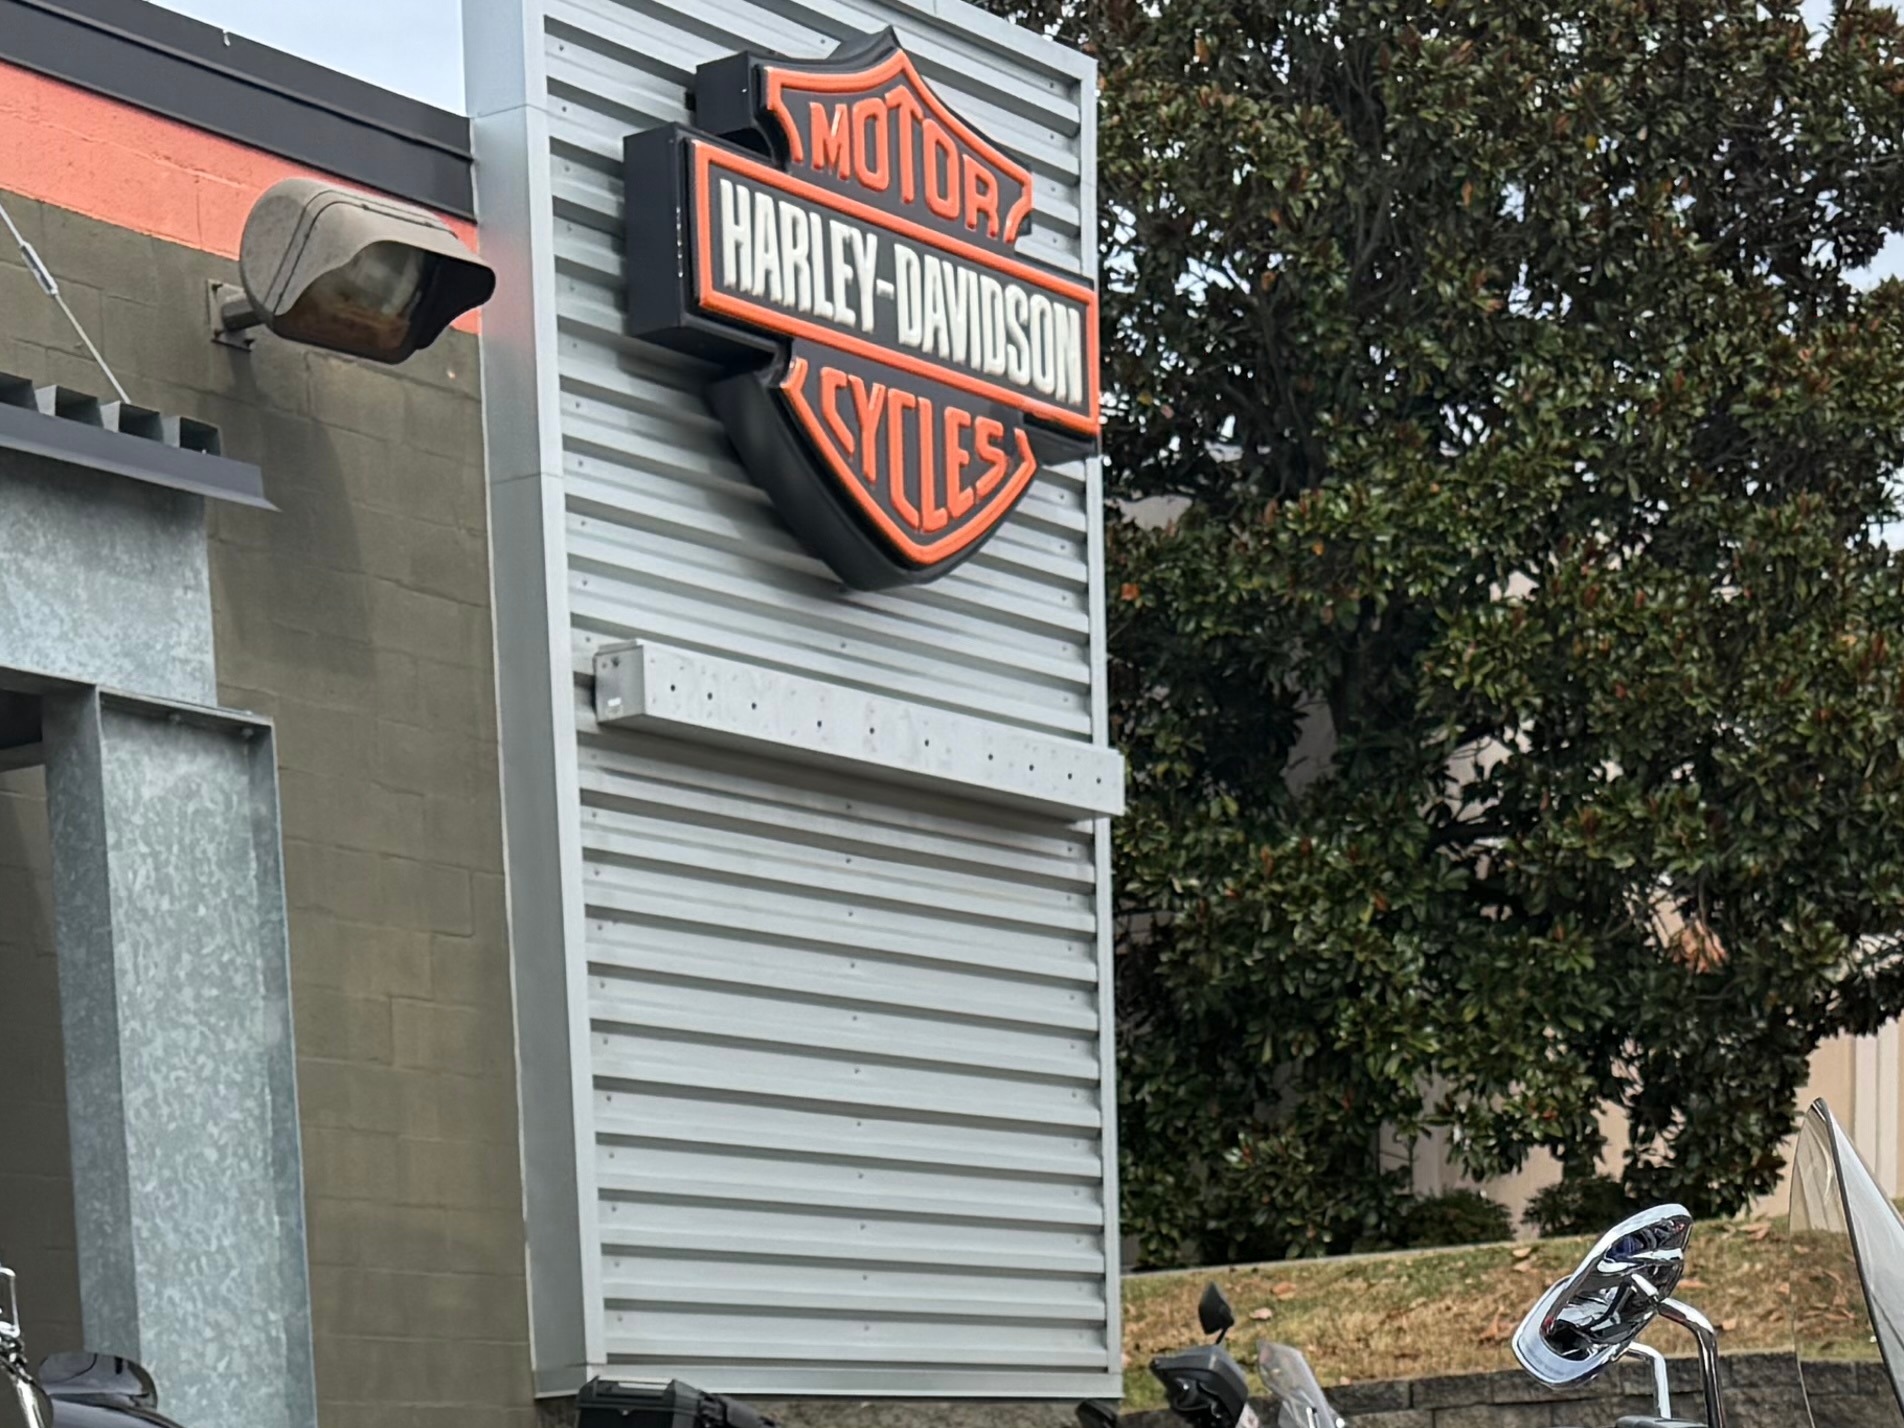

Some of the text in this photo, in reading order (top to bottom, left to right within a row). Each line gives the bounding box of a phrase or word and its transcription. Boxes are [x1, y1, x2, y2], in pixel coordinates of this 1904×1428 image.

[809, 84, 999, 240] MOTOR
[718, 178, 1084, 405] HARLEY-DAVIDSON
[819, 366, 1012, 535] CYCLES
